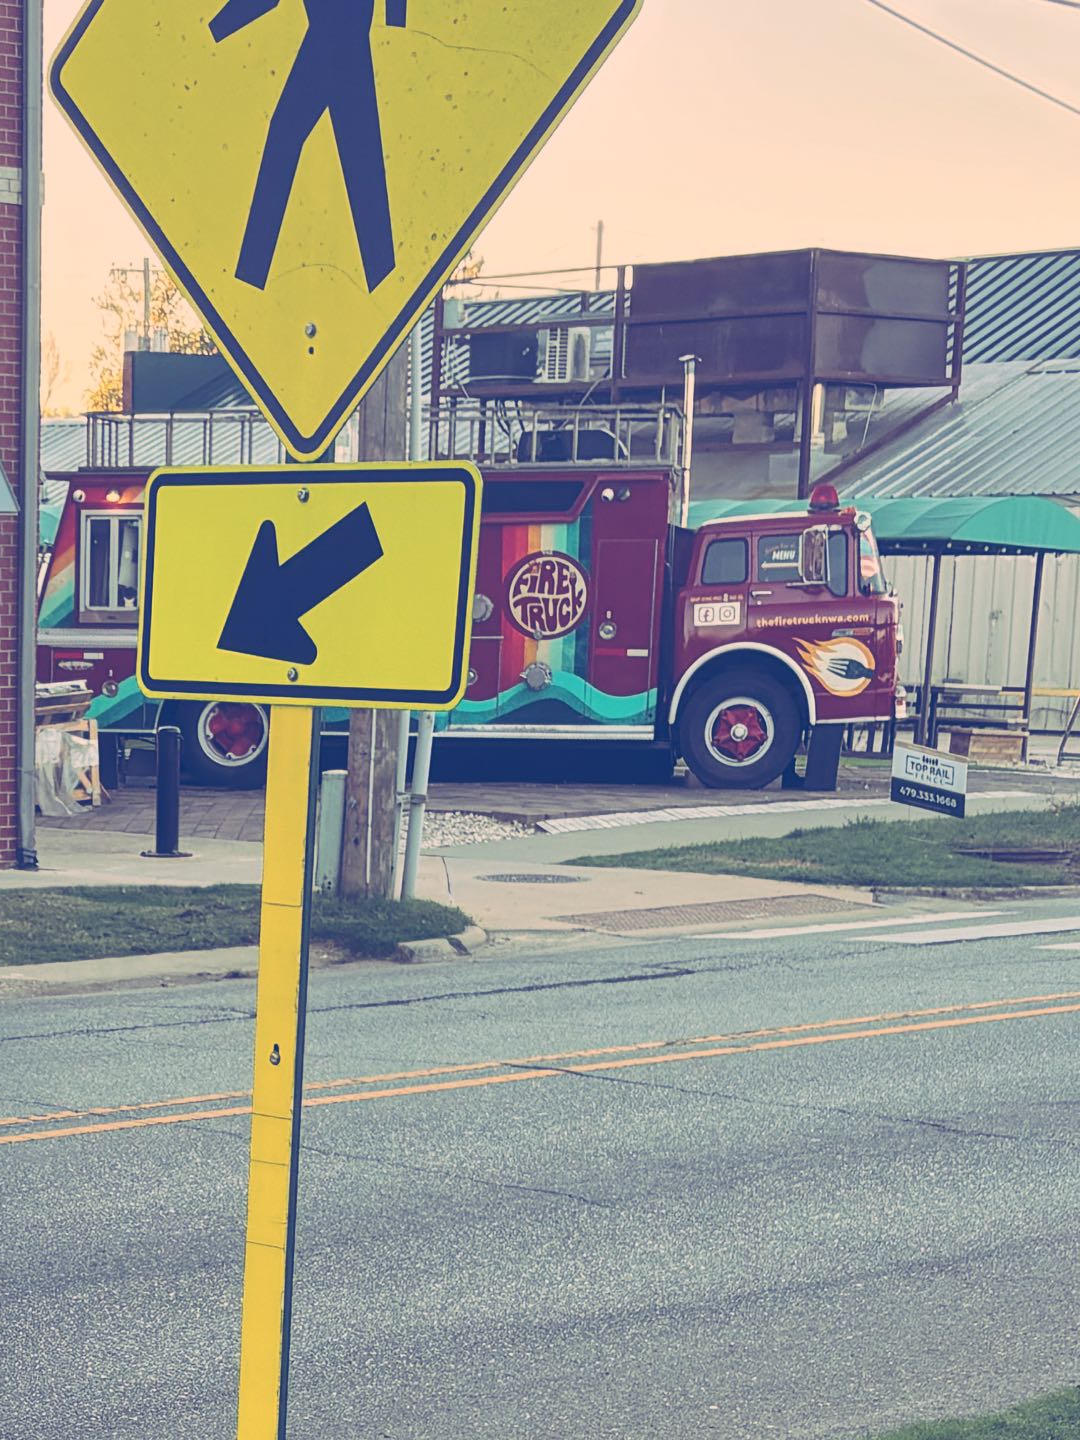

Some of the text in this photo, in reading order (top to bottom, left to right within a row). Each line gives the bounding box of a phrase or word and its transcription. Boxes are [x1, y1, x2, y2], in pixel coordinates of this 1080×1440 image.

[512, 573, 584, 632] TRUCK
[910, 760, 950, 780] TOP RAIL
